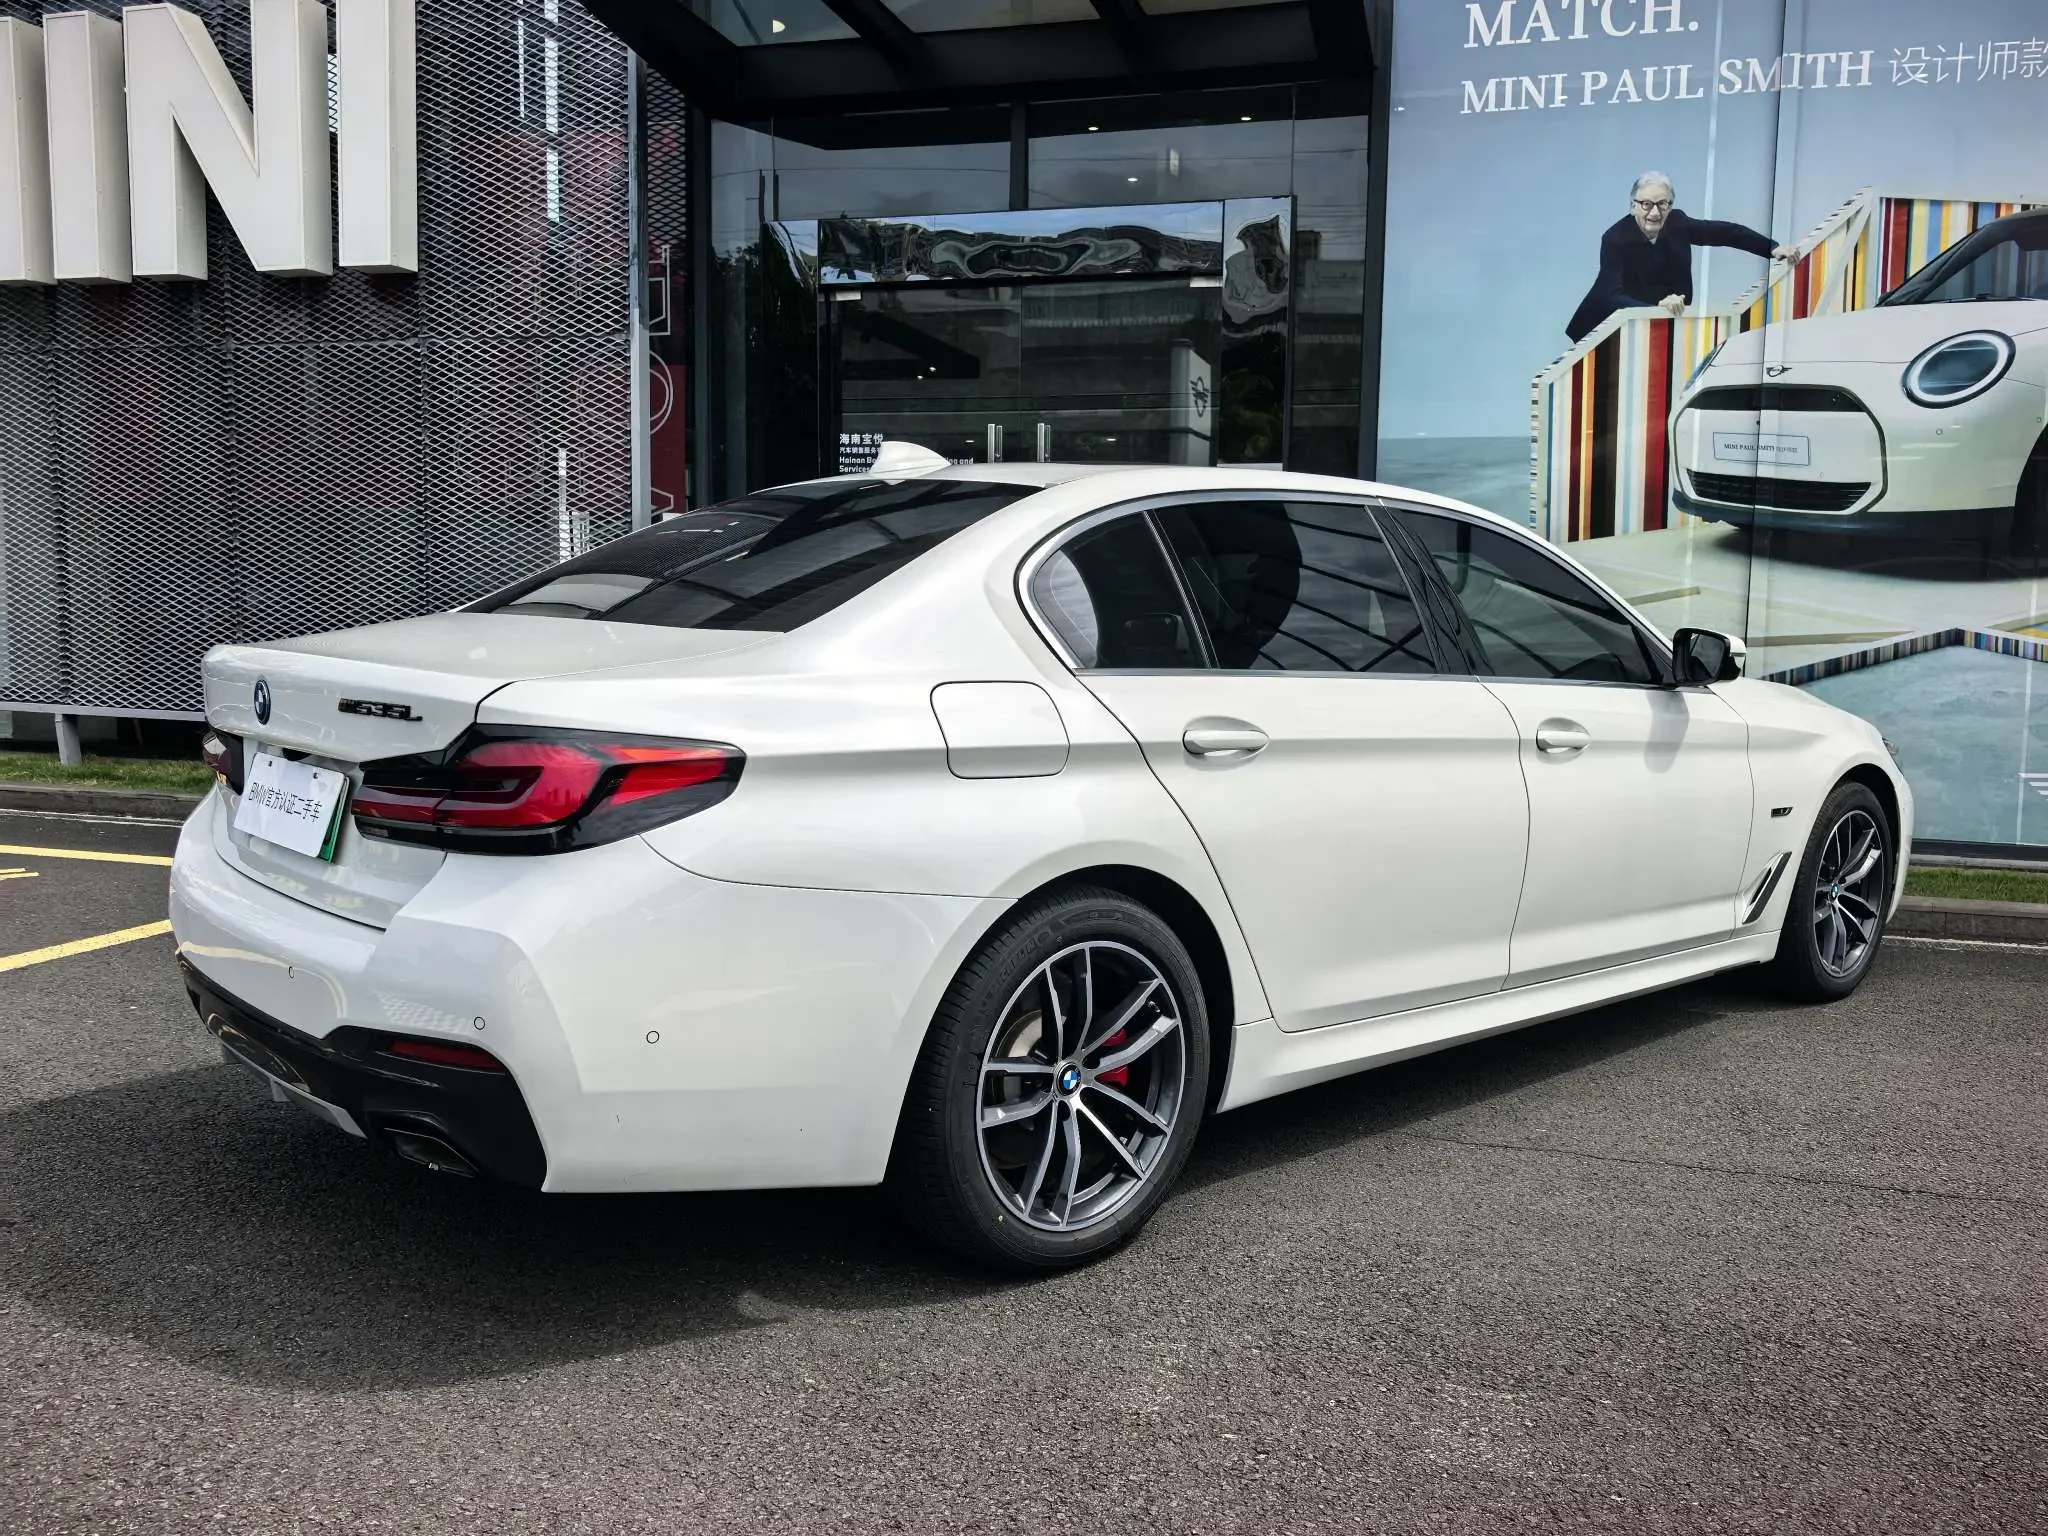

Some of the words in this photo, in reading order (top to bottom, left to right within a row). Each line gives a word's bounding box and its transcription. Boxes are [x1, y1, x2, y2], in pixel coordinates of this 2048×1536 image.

[1464, 0, 1699, 48] MATCH.
[1460, 74, 1568, 114] MINI
[1580, 65, 1704, 106] PAUL
[1718, 50, 1874, 95] SMITH
[1889, 36, 2048, 87] 设计师款
[839, 456, 865, 464] Hainan
[959, 457, 974, 465] and
